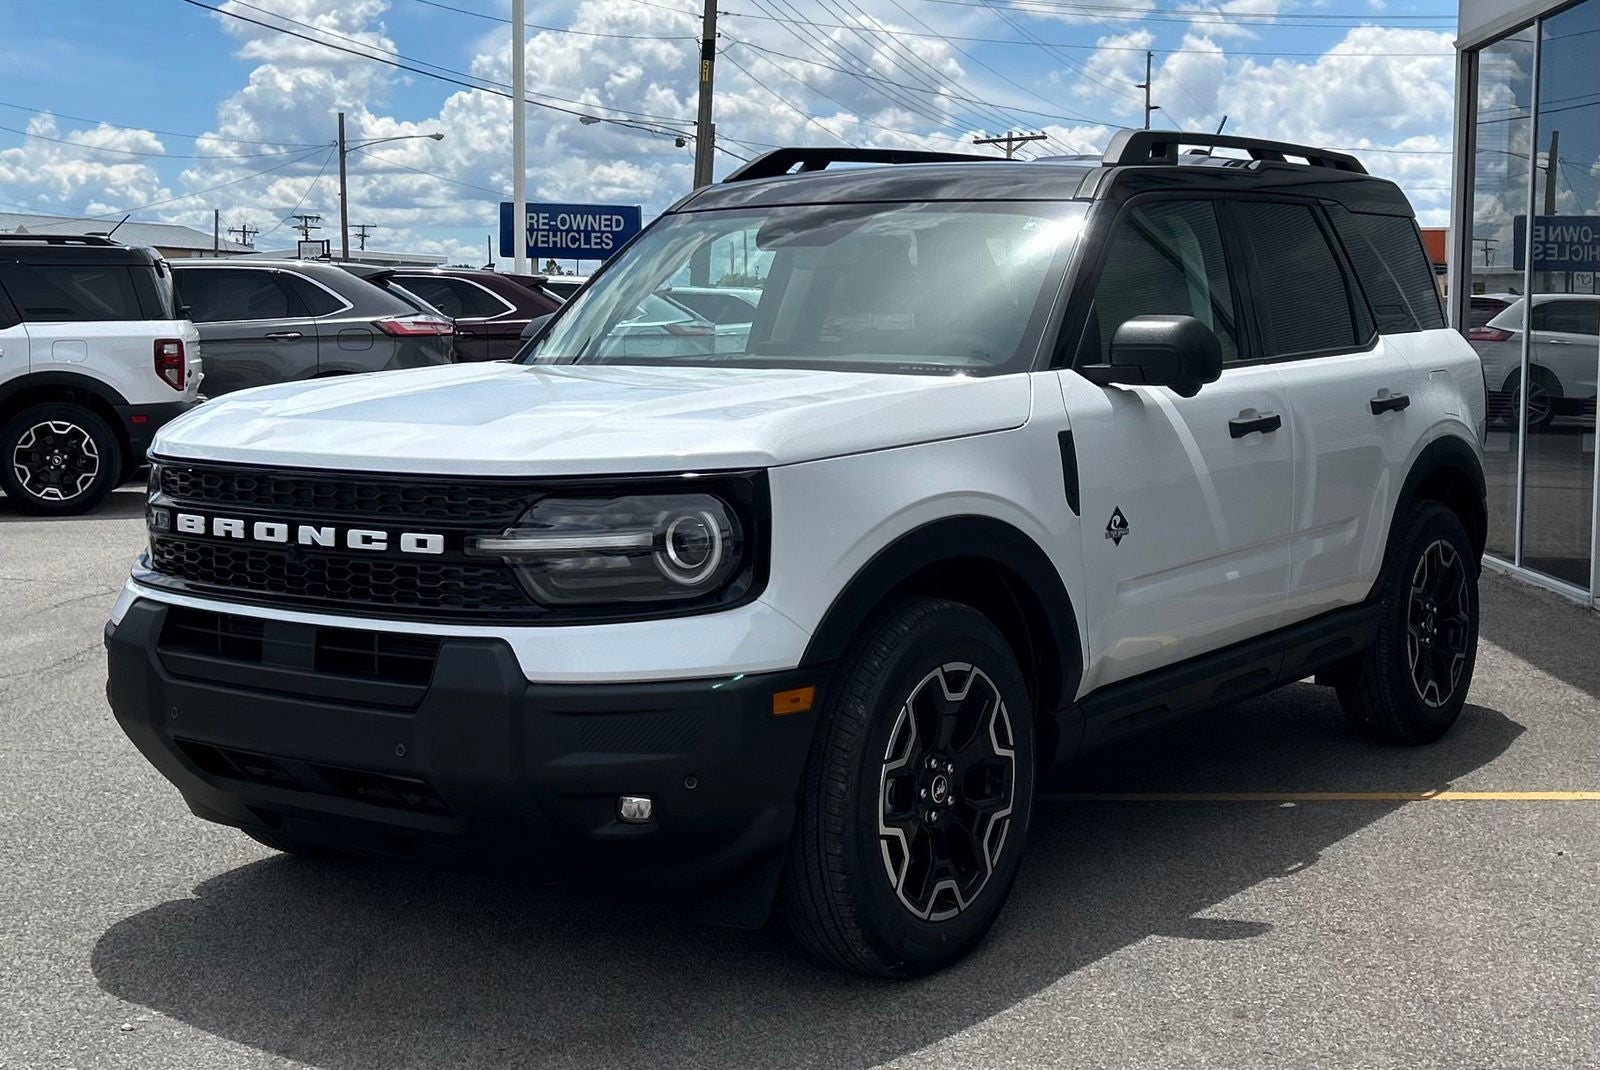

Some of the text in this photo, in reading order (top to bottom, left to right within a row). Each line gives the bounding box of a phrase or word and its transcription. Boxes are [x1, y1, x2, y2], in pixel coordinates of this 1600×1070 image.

[526, 213, 625, 231] RE-OWNED
[526, 231, 613, 249] VEHICLES
[176, 513, 444, 554] BRONCO
